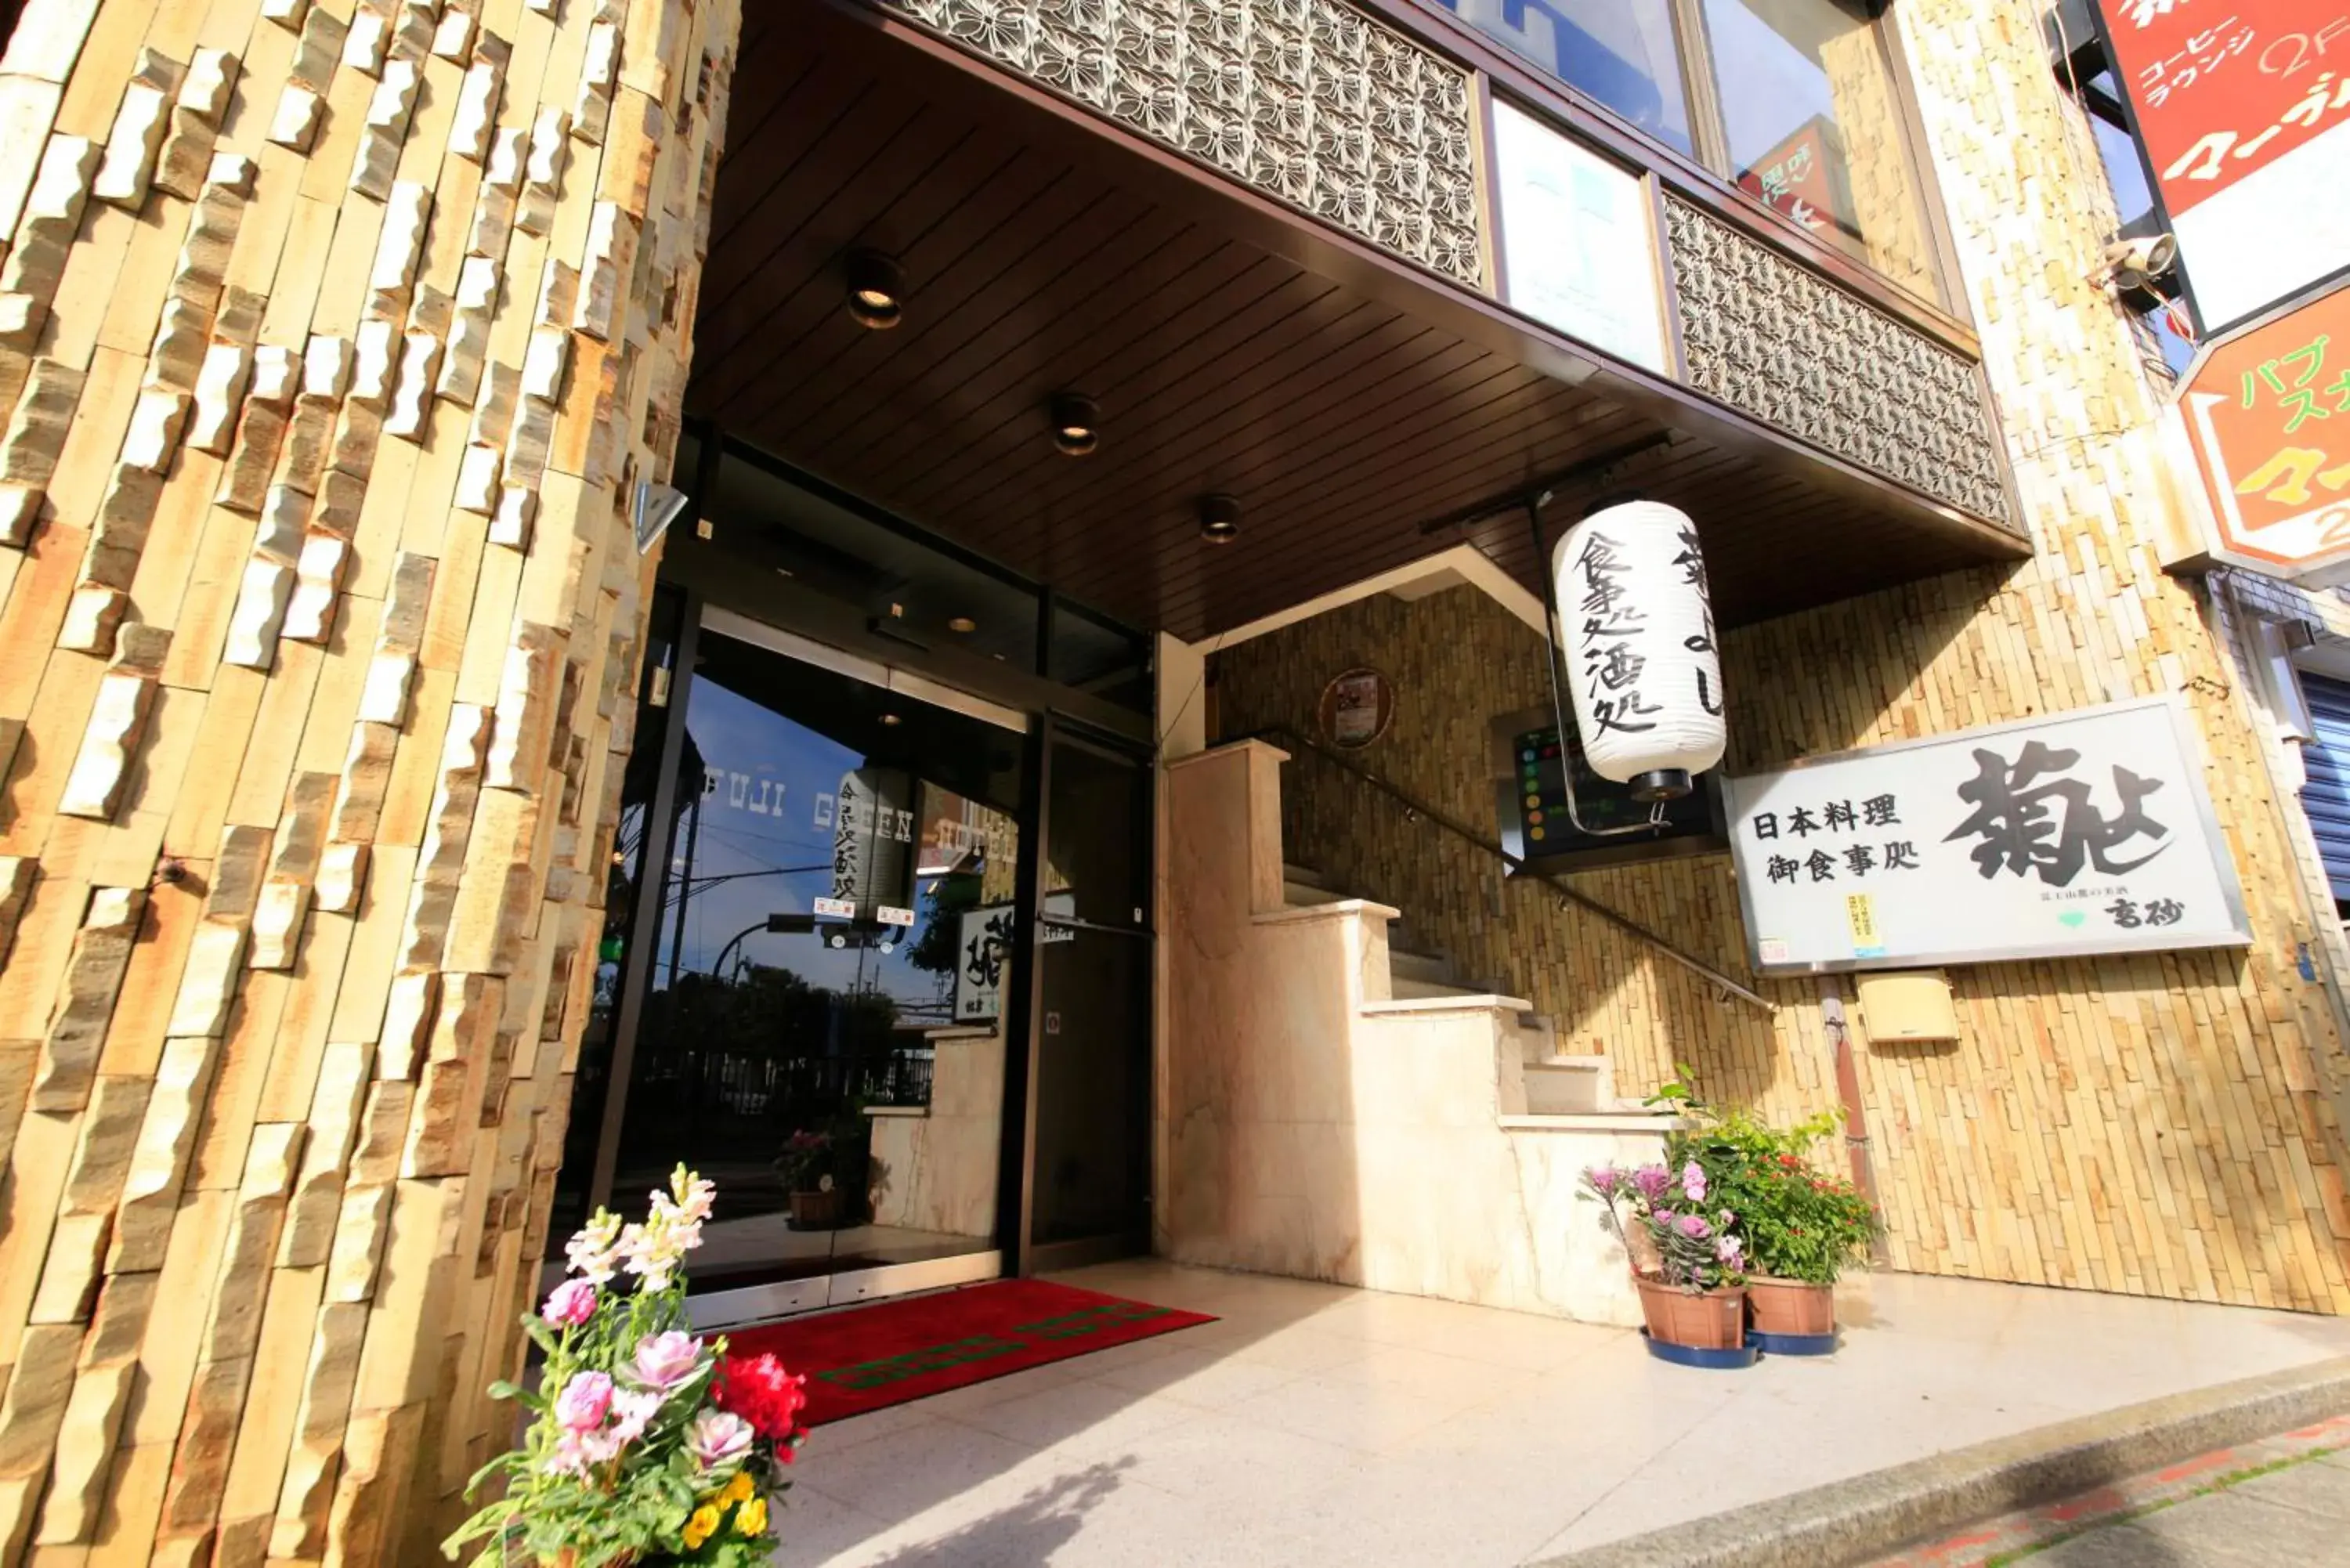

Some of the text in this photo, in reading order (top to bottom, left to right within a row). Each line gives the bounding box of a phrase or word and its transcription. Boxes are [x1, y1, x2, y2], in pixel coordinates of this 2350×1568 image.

[2138, 16, 2238, 89] コーヒー
[2146, 26, 2256, 108] ラウンジ
[700, 766, 786, 817] FUJI
[1753, 793, 1902, 840] 日本料理
[1767, 840, 1921, 884] 御食事処
